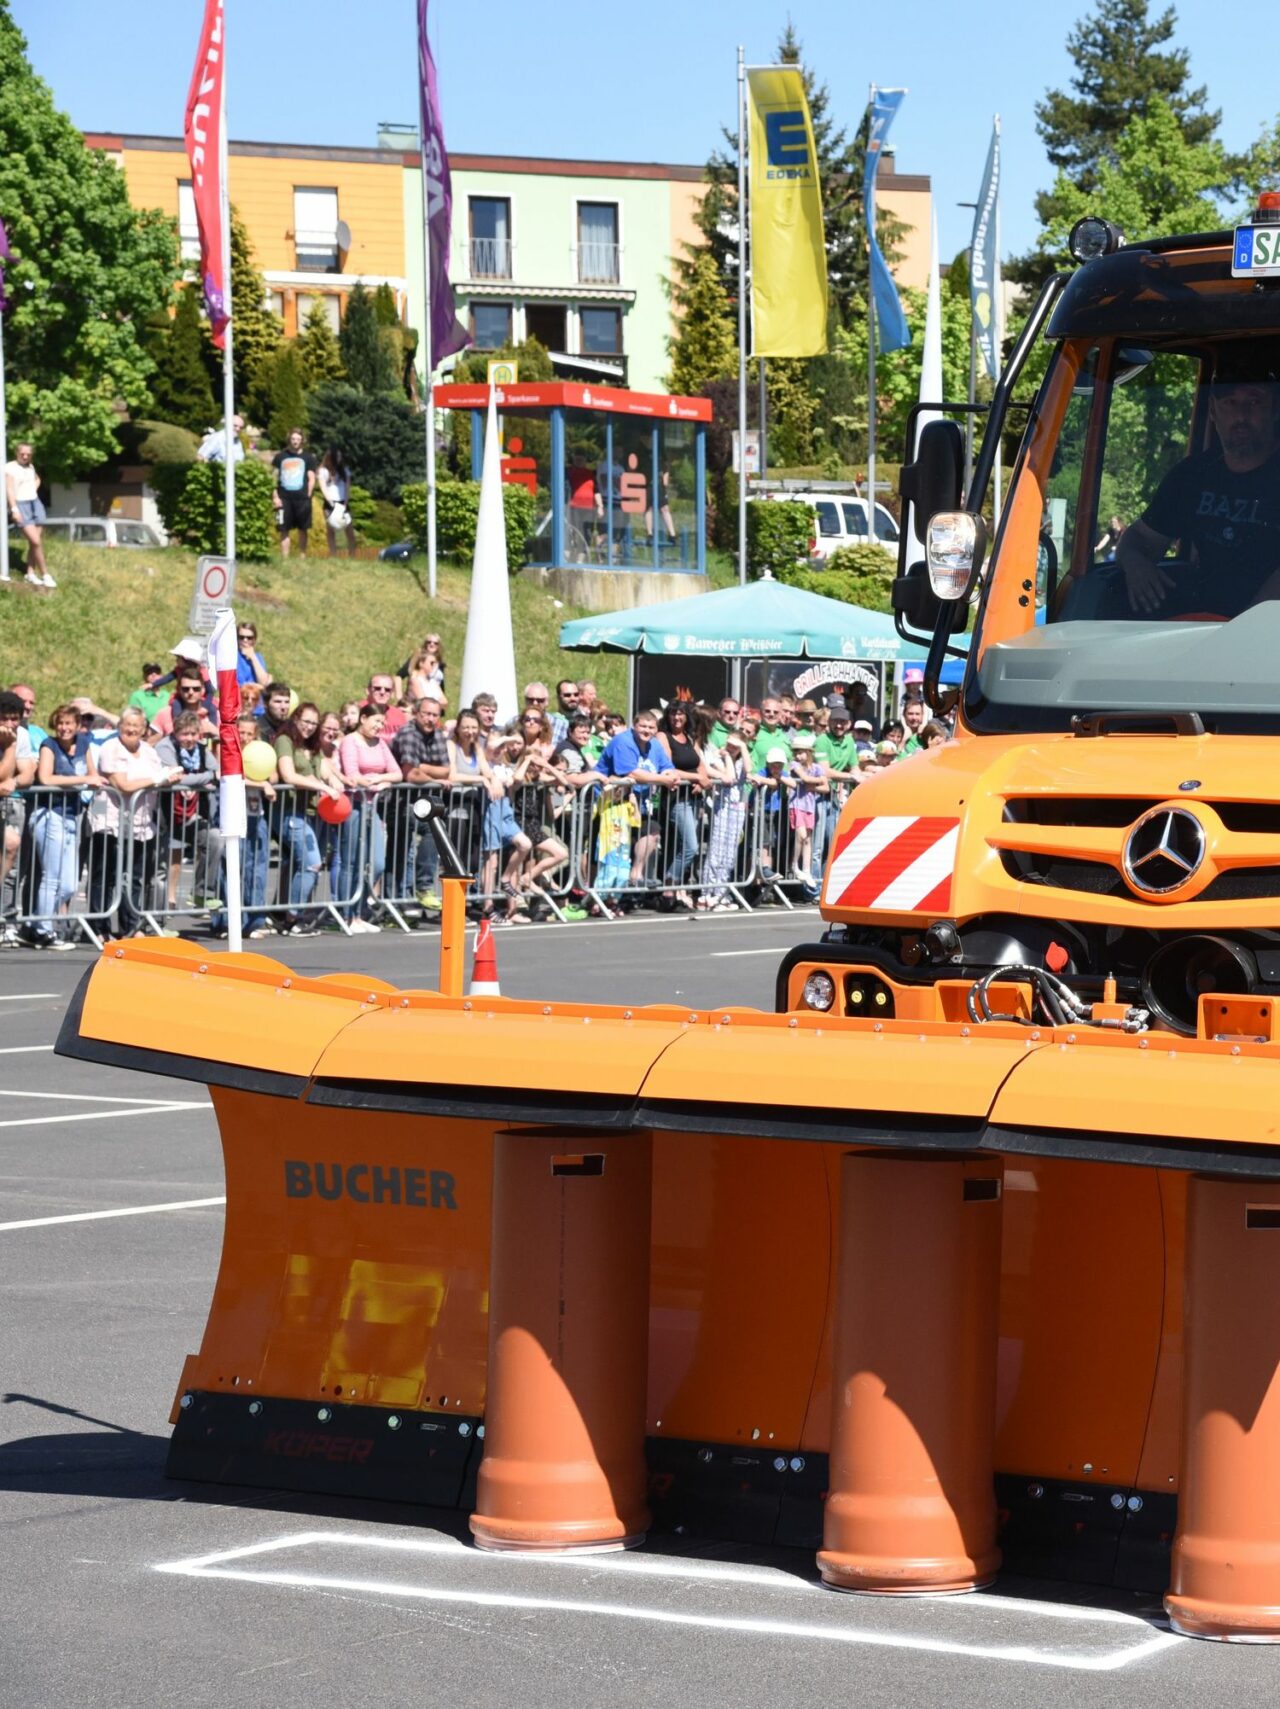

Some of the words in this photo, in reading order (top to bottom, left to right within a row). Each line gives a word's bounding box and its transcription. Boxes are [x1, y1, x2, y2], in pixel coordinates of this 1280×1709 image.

[766, 168, 811, 180] EDEKA
[1240, 253, 1248, 263] D
[793, 661, 879, 700] GRILLFACHHANDEL
[284, 1160, 459, 1210] BUCHER
